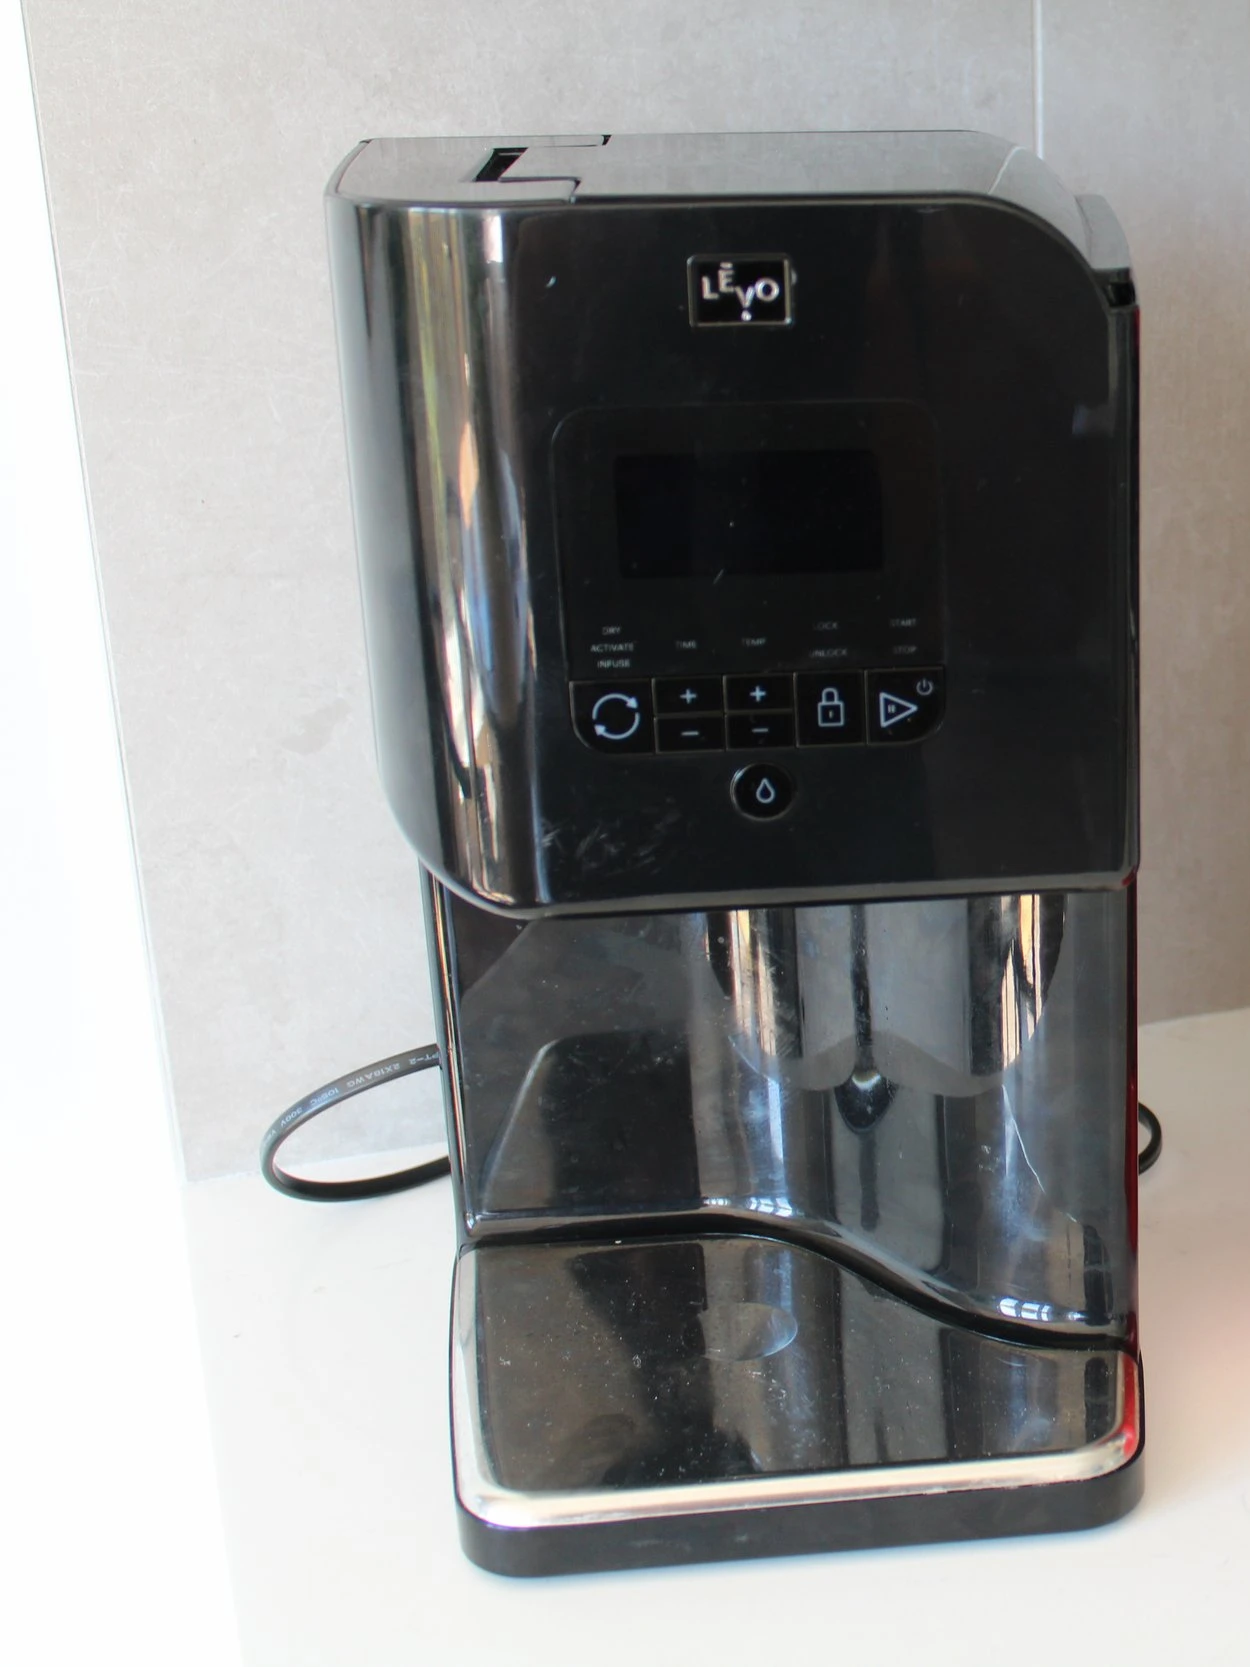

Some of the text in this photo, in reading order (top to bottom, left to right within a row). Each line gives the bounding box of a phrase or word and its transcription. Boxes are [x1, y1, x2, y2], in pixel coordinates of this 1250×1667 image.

[812, 622, 839, 630] LOCK
[890, 619, 916, 627] START
[602, 626, 621, 635] DRY
[590, 642, 634, 652] ACTIVATE
[675, 641, 697, 650] TIME
[742, 638, 766, 647] TEMP
[809, 649, 847, 658] UNLOCK
[893, 646, 917, 654] STOP
[597, 659, 630, 668] INFUSE
[280, 1107, 302, 1126] 300V
